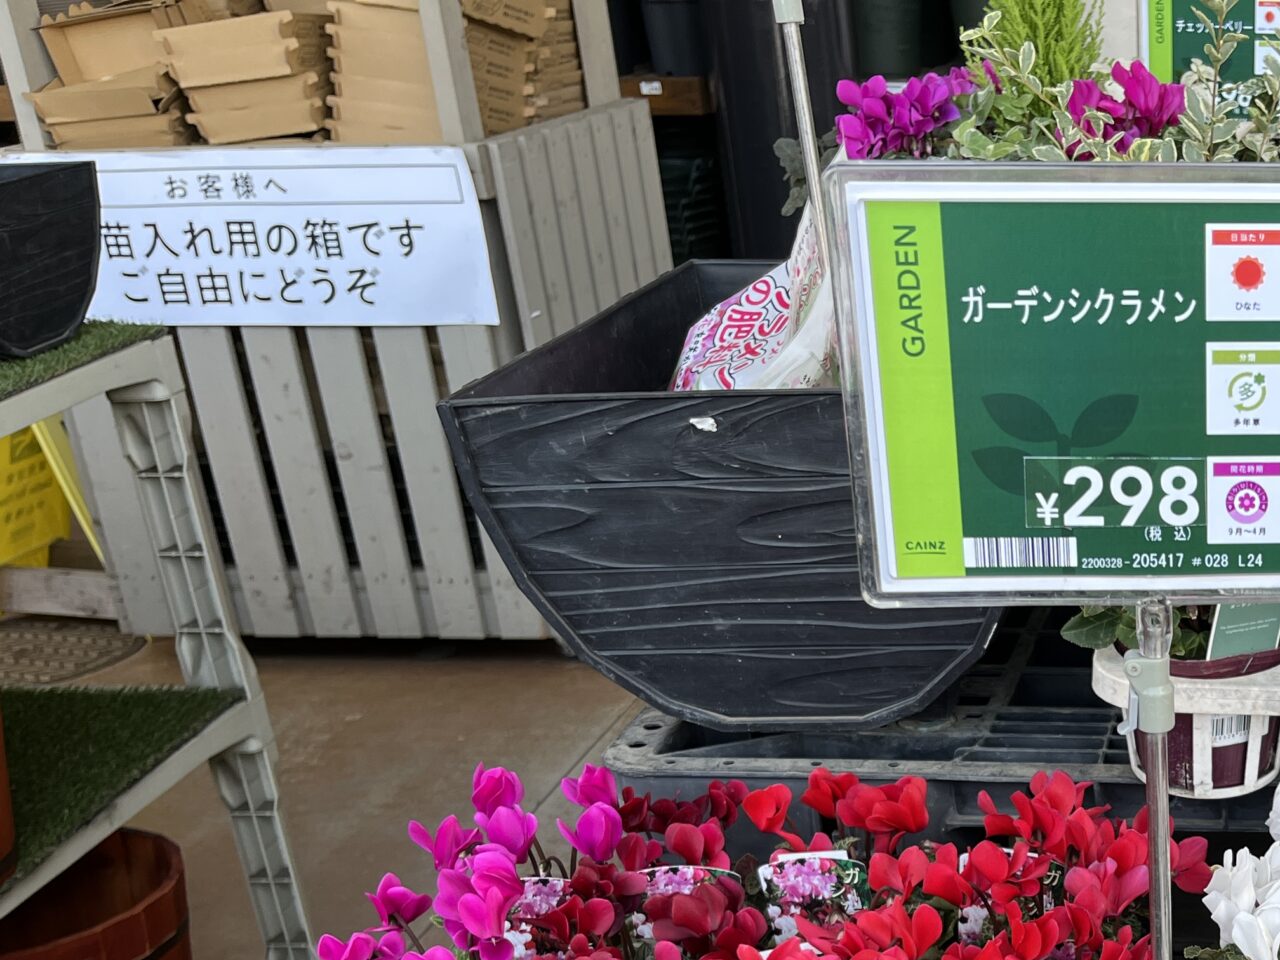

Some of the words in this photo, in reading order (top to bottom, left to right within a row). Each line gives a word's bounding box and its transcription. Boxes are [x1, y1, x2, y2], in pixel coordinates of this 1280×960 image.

[165, 171, 288, 200] お客様へ
[100, 219, 425, 261] 苗入れ用の箱です
[1230, 233, 1266, 243] 日当たり
[122, 265, 380, 306] ご自由にどうぞ
[893, 224, 926, 358] GARDEN
[961, 285, 1197, 325] ガーデンシクラメン
[1235, 301, 1262, 311] ひなた
[1035, 465, 1200, 527] ¥298
[905, 541, 946, 551] CAINZ
[1238, 553, 1263, 568] L24
